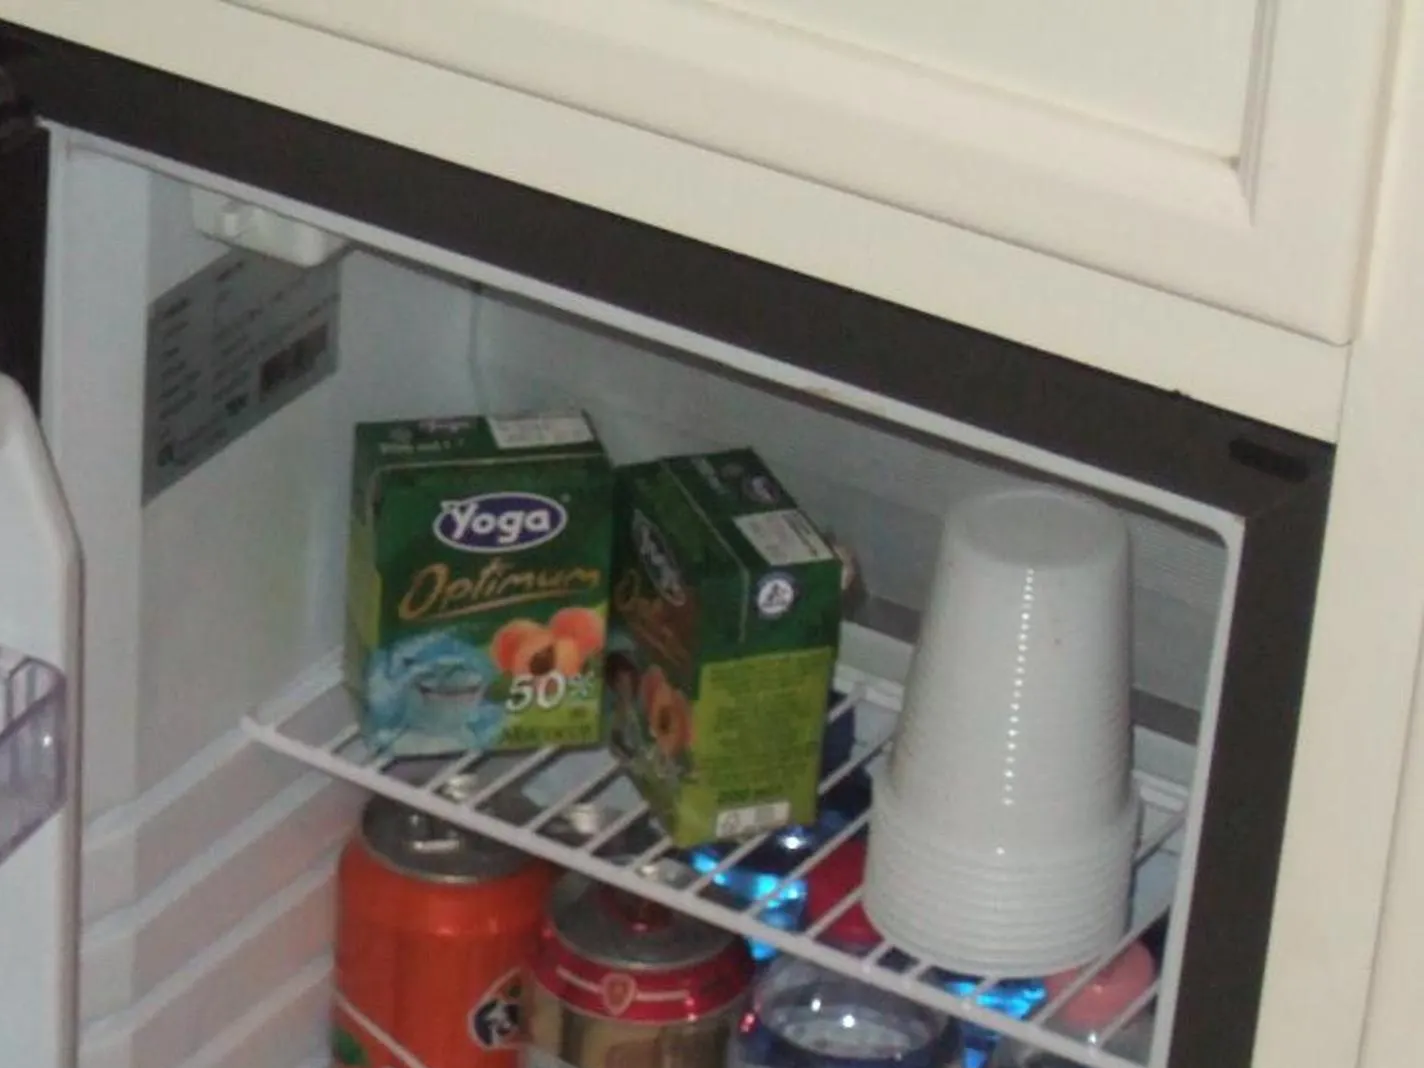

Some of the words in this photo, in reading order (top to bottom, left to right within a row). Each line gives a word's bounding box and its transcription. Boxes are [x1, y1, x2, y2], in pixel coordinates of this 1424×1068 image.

[439, 499, 552, 545] Yoga
[397, 556, 601, 621] Optimum
[505, 668, 595, 711] 50%
